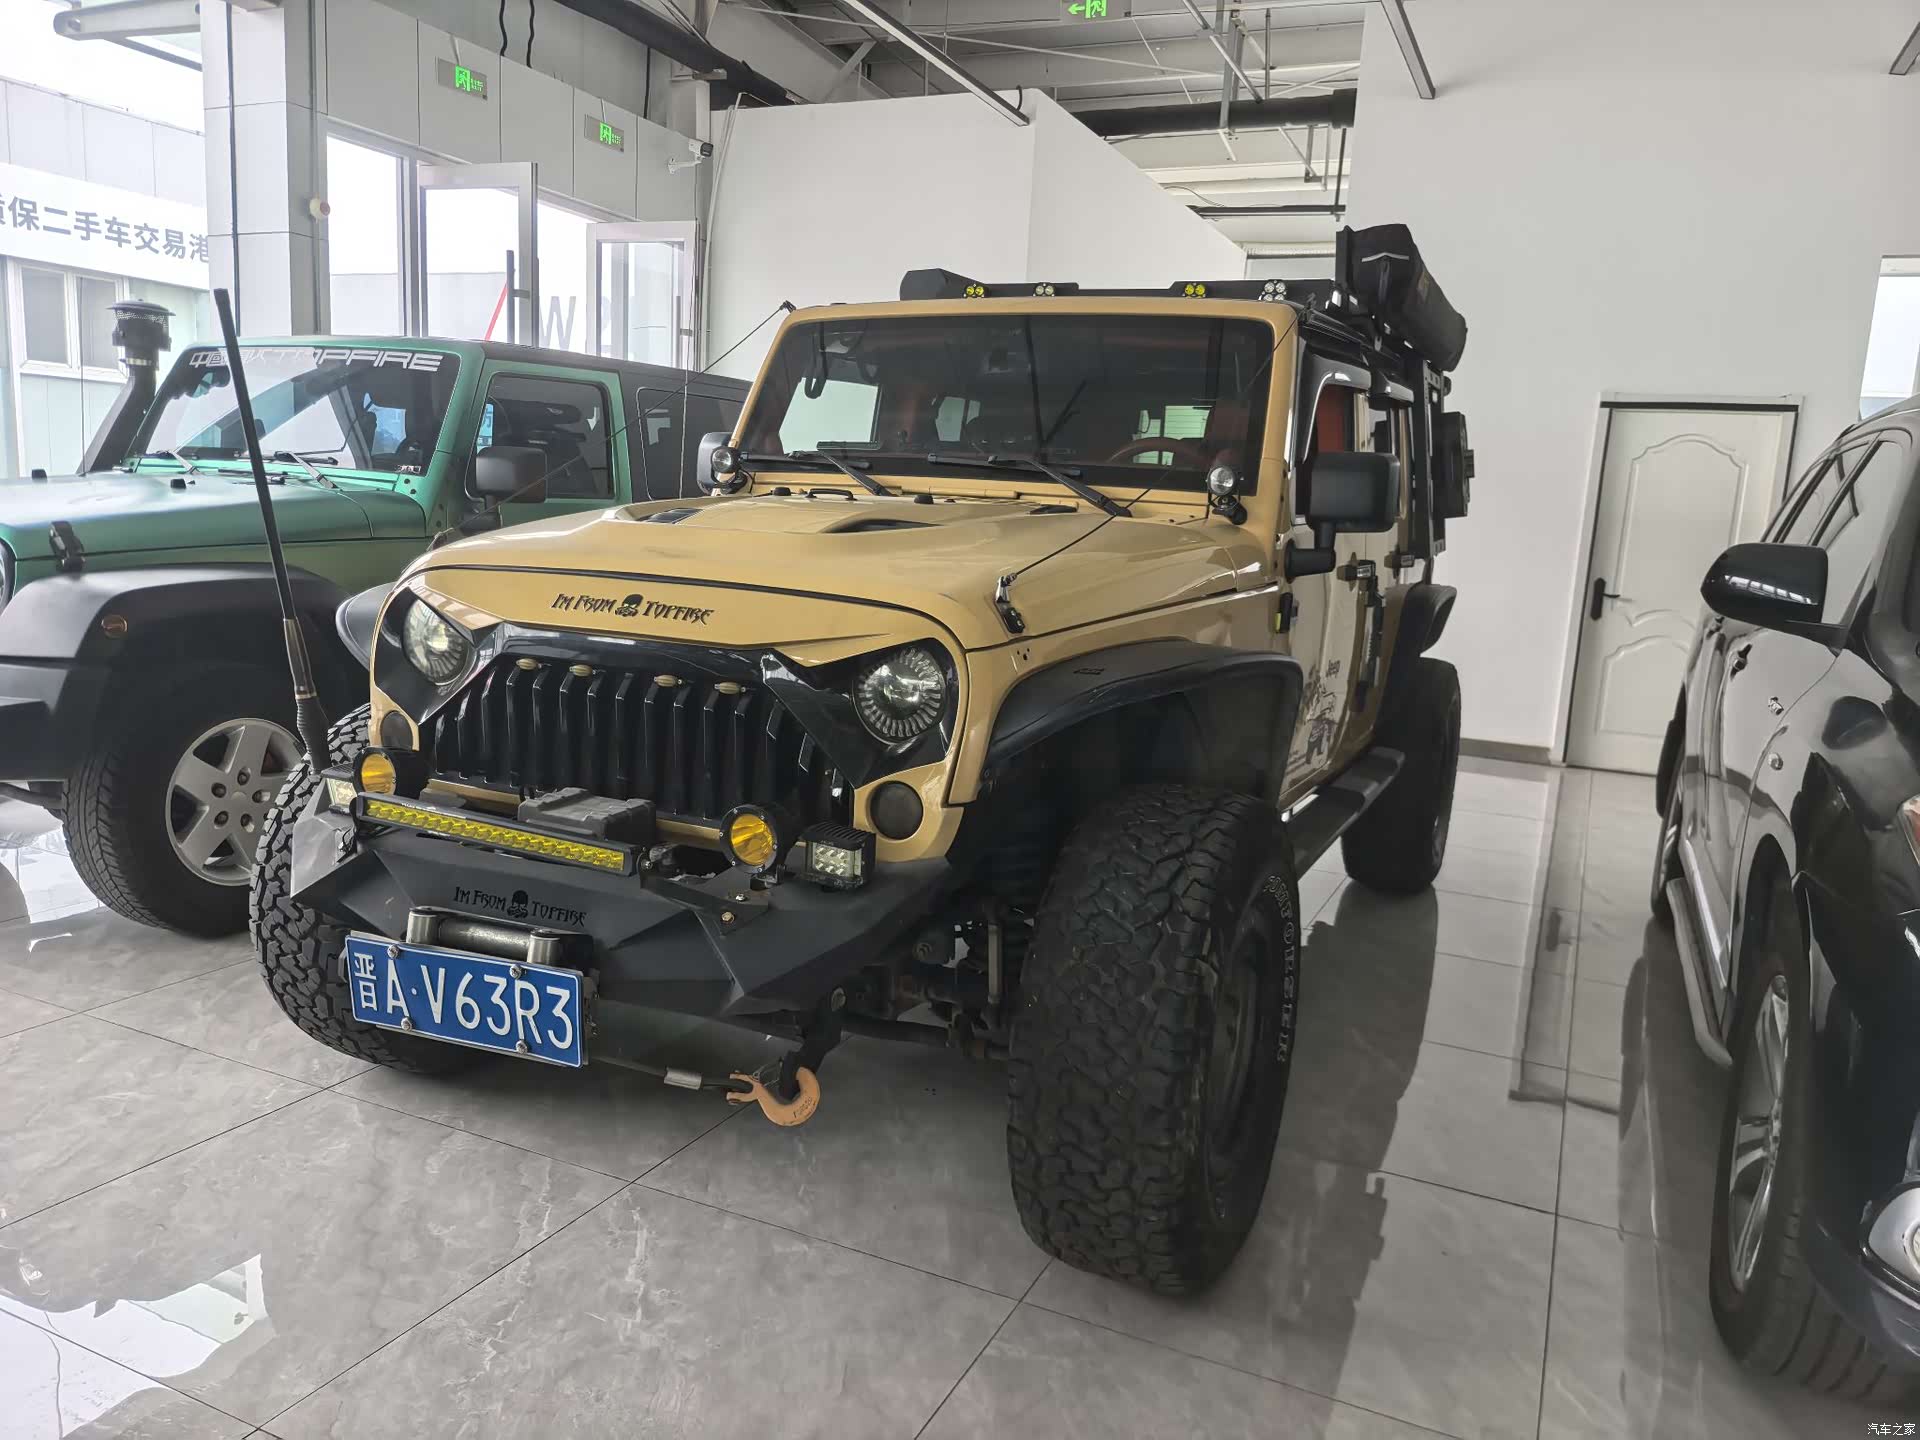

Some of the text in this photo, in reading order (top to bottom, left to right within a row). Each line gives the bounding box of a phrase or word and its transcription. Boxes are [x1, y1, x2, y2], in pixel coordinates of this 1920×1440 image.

[0, 195, 209, 263] 保二手车交易港
